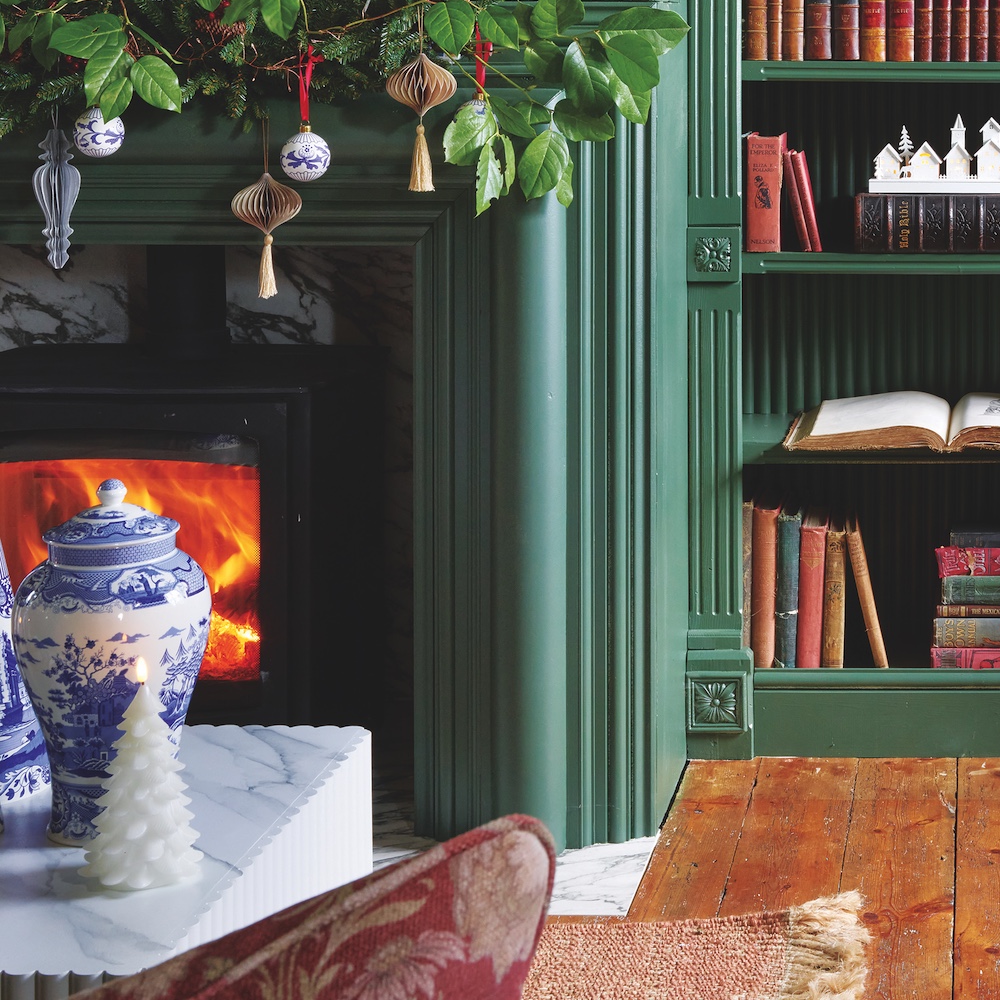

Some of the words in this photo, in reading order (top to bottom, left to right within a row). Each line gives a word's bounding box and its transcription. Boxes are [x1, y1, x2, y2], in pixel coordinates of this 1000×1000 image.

[898, 200, 910, 227] Bible
[899, 228, 911, 249] Holy
[942, 548, 961, 577] TRUE
[943, 619, 954, 647] BOY'S
[954, 619, 966, 648] OWN
